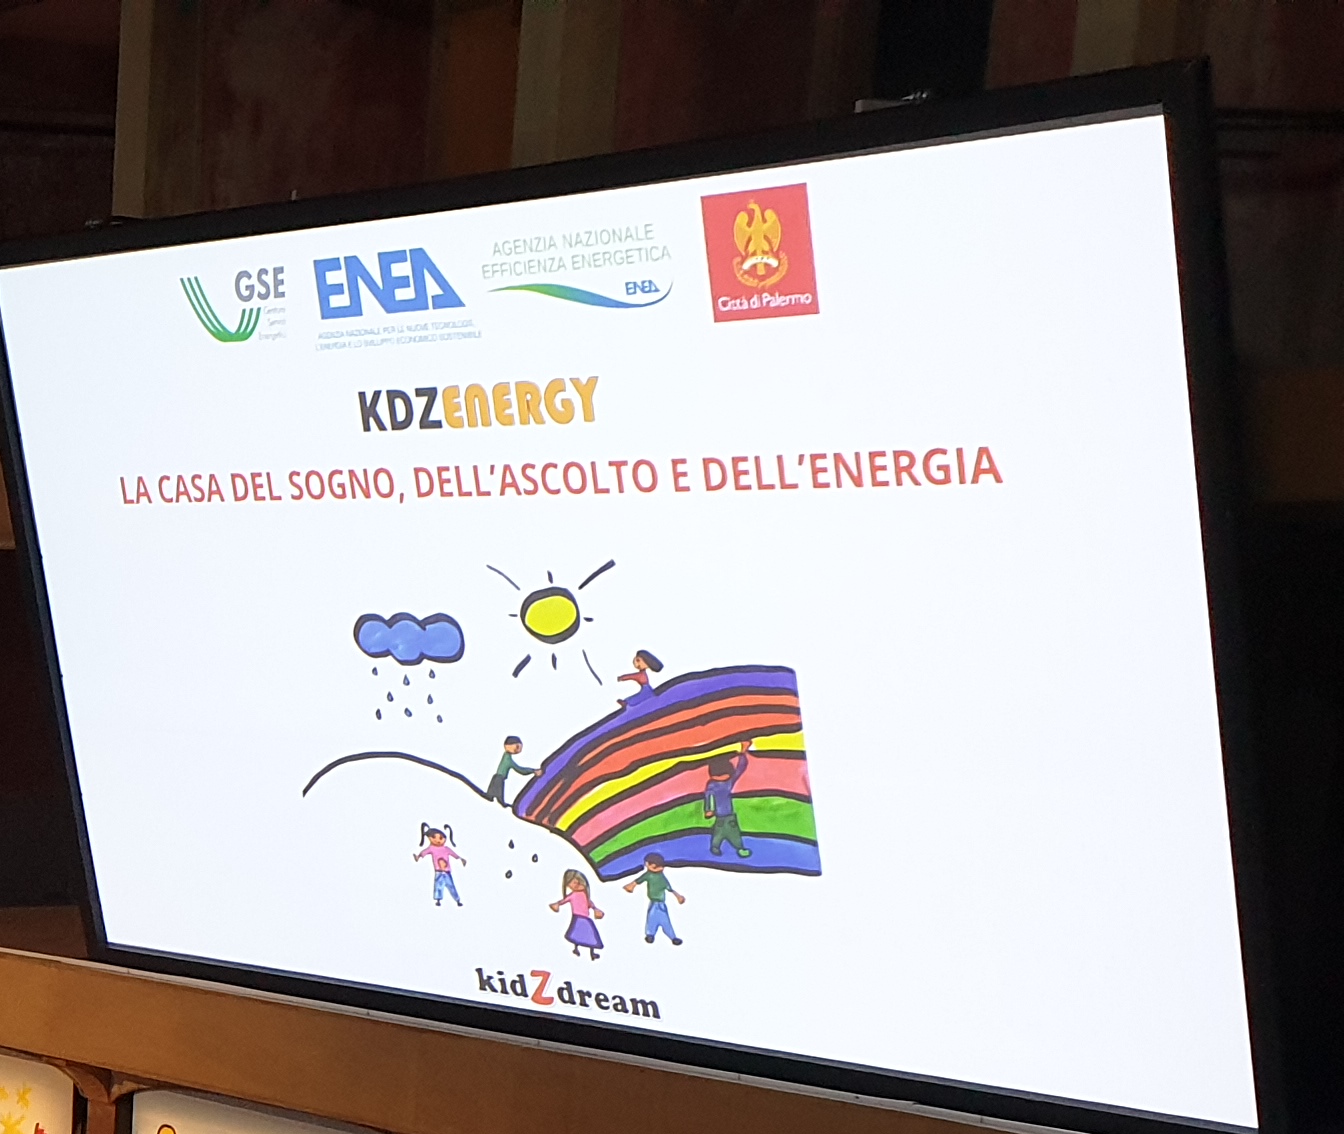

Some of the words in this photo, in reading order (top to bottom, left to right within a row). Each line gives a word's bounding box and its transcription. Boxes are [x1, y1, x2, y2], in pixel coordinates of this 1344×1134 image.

[492, 235, 559, 257] AGENZIA
[562, 223, 655, 250] NAZIONALE
[481, 256, 568, 280] EFFICIENZA
[572, 245, 672, 271] ENERGETICA
[235, 266, 286, 303] GSE
[313, 247, 466, 320] ENEA
[625, 280, 660, 296] ENEA
[750, 294, 761, 309] di
[762, 291, 813, 308] Palermo
[119, 473, 153, 504] LA
[158, 472, 226, 504] CASA
[232, 471, 283, 503] DEL
[289, 466, 406, 505] SOGNO,
[414, 458, 659, 499] DELL'ASCOLTO
[673, 458, 691, 493] E
[702, 446, 1003, 494] DELL'ENERGIA
[475, 967, 661, 1020] kidZdream
